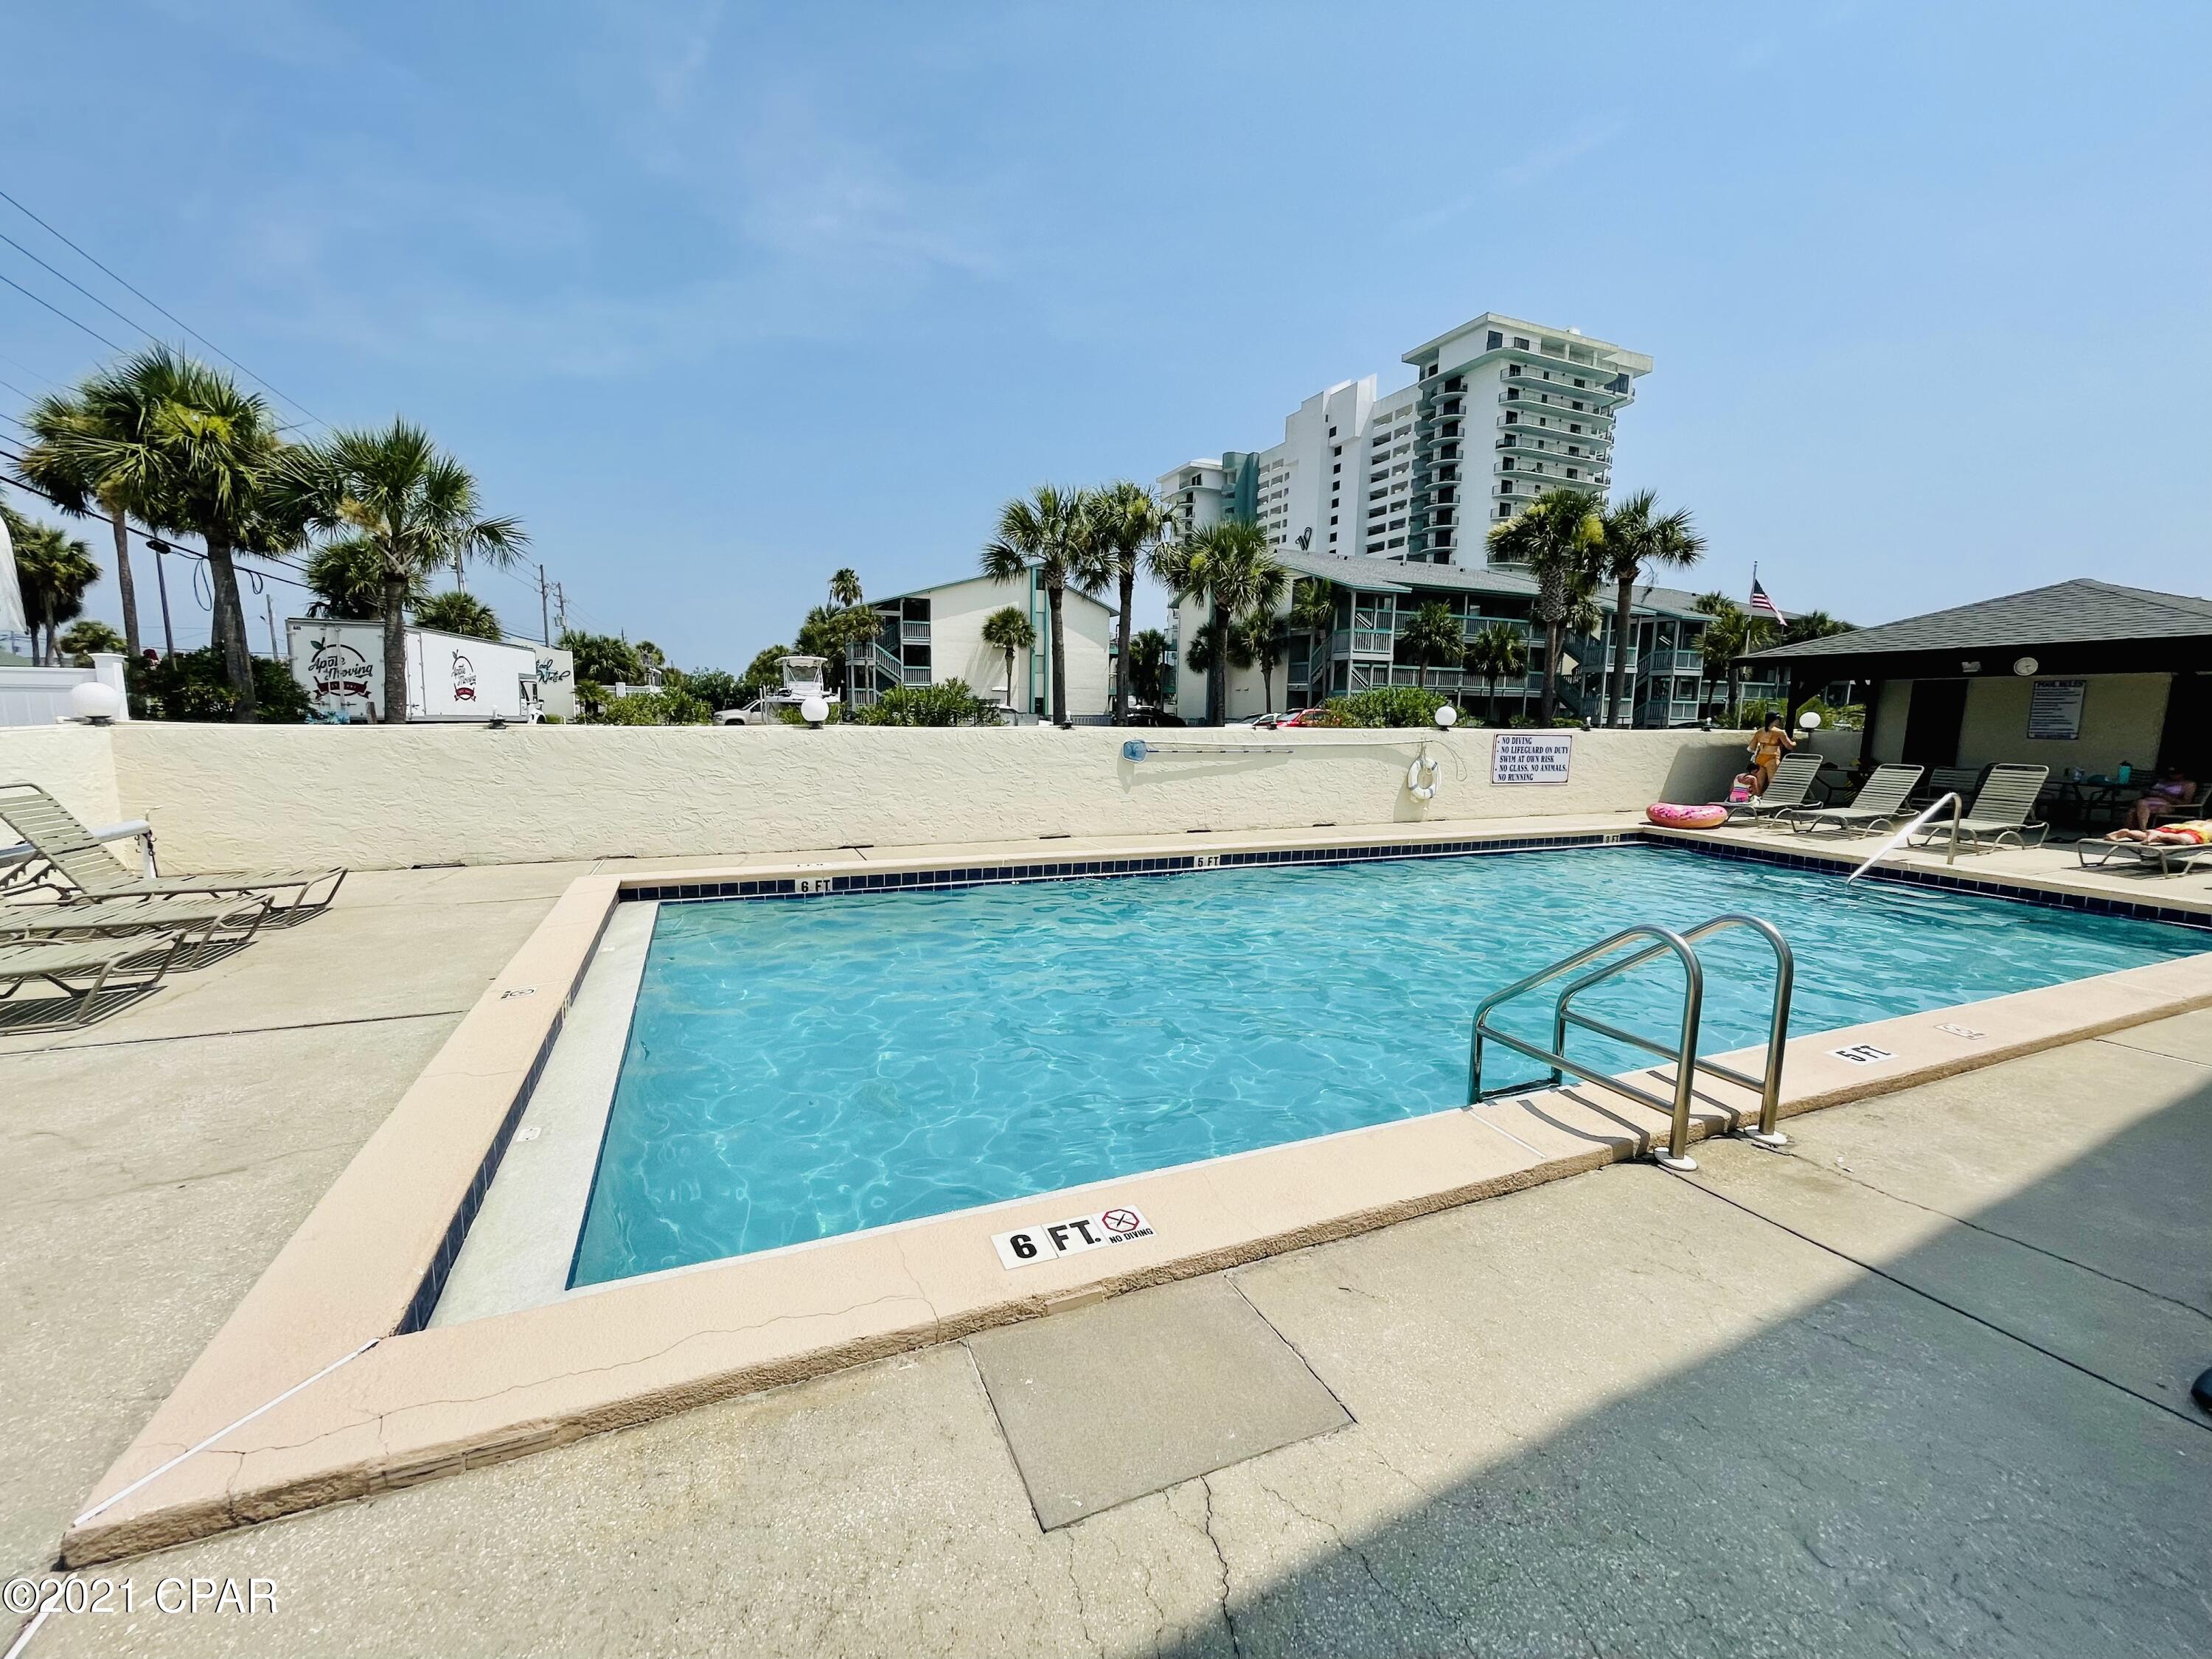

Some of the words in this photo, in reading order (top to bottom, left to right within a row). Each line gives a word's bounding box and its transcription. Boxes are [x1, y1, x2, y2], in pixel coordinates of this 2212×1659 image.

[308, 655, 346, 673] Apple
[324, 664, 373, 681] Moving
[1512, 737, 1532, 745] DIVING
[1499, 764, 1508, 772] NO
[1531, 764, 1539, 772] NO
[1508, 773, 1534, 781] RUNNING
[1606, 835, 1610, 844] 3
[1612, 835, 1619, 843] FT
[1197, 857, 1204, 867] 5
[1207, 856, 1219, 866] FT
[801, 880, 809, 893] 6
[815, 879, 831, 892] FT.
[1835, 1049, 1867, 1062] 5
[1851, 1044, 1892, 1060] FT
[1009, 1234, 1037, 1259] 6
[1047, 1220, 1102, 1251] FT.
[1109, 1232, 1123, 1244] NO
[1125, 1228, 1154, 1240] DIVING
